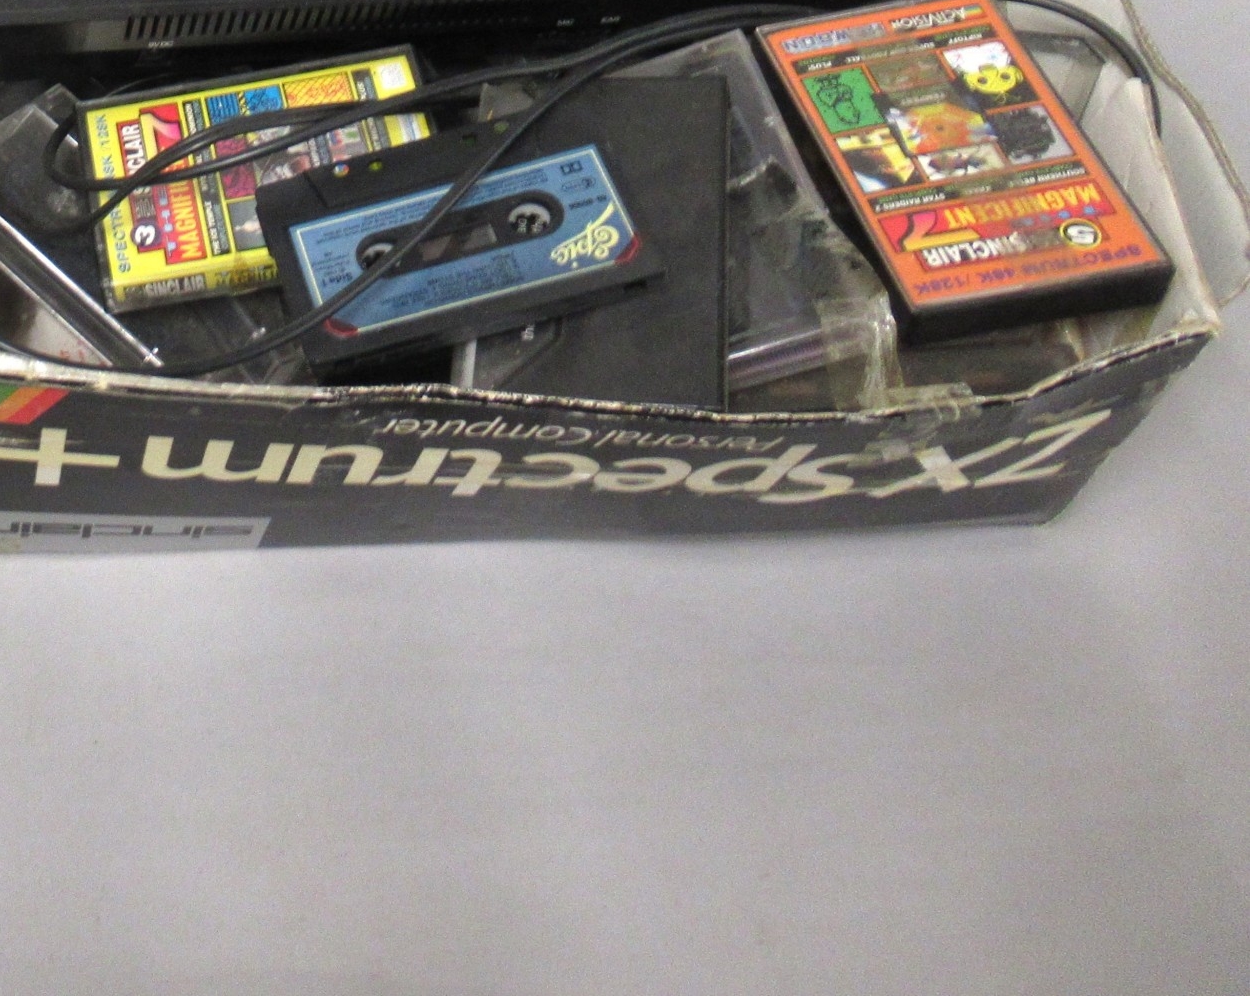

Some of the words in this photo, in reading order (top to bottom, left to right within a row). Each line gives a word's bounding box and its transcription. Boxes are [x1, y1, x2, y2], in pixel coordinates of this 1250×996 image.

[140, 111, 182, 157] 7
[134, 224, 156, 245] 3
[550, 204, 620, 269] Epic
[902, 210, 981, 254] 7
[1066, 224, 1095, 245] 5
[382, 416, 591, 447] Computer
[593, 429, 786, 452] Personal
[869, 408, 1112, 498] ZX
[141, 436, 856, 504] Spectrum
